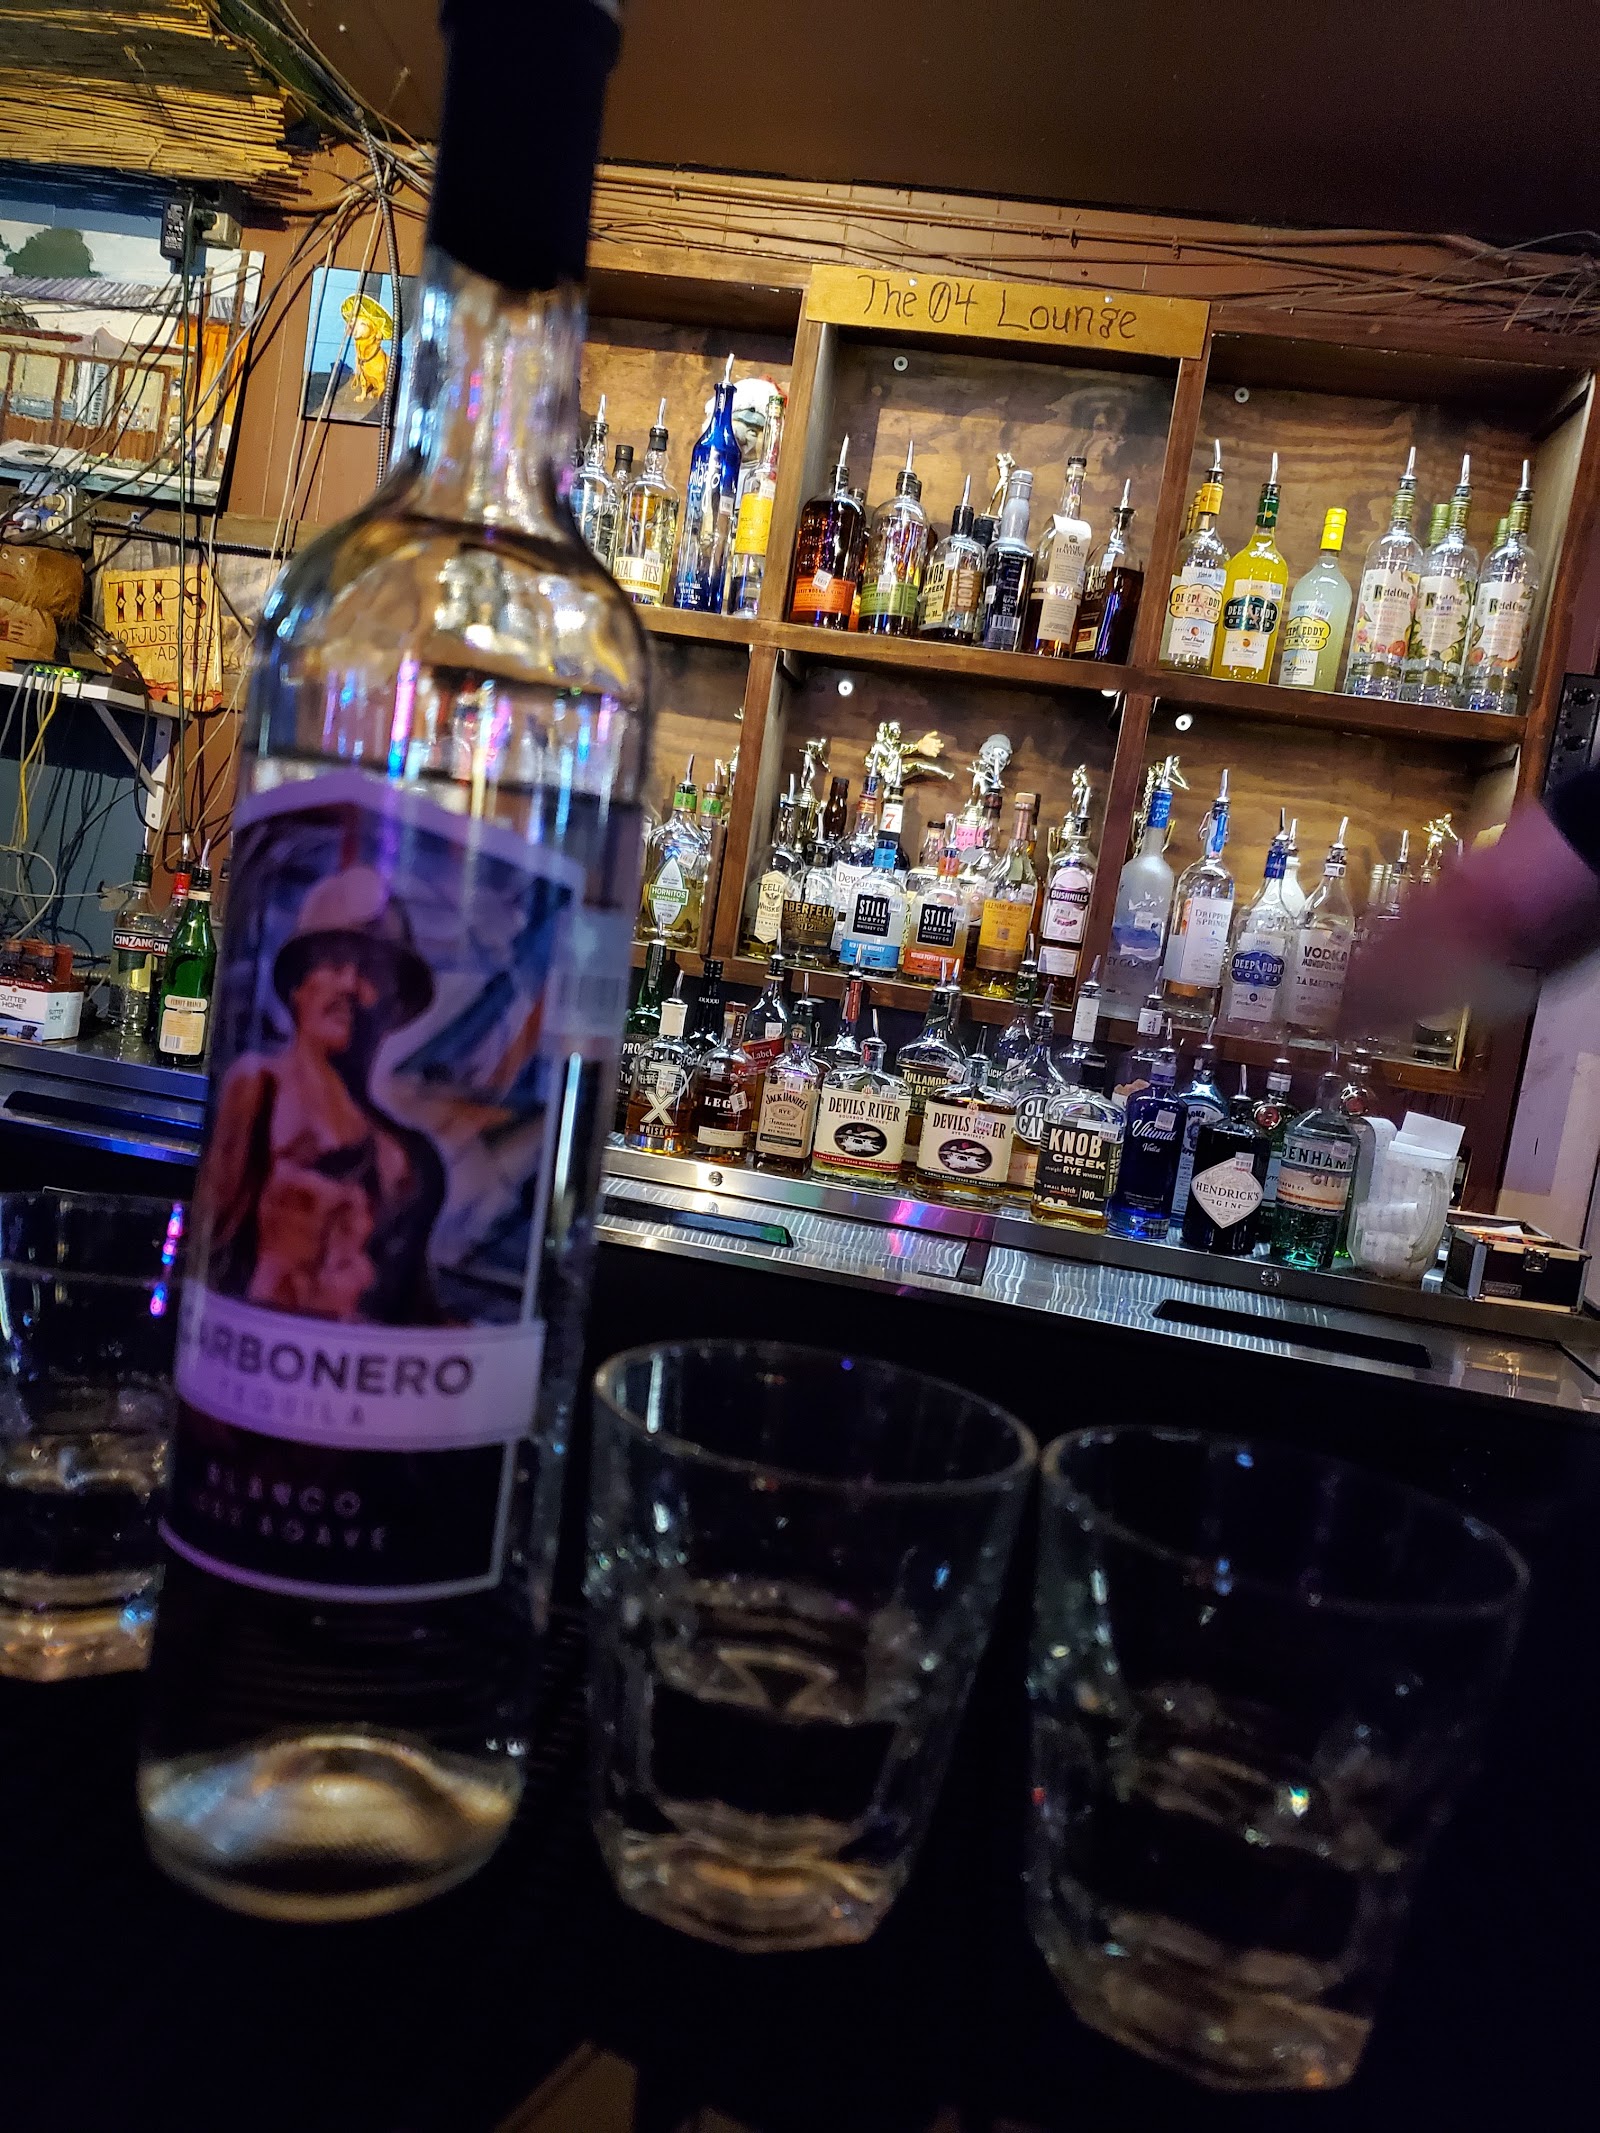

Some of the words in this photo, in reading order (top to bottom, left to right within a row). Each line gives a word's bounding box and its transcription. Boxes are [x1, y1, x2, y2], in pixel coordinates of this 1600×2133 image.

[857, 274, 917, 317] The
[998, 289, 1137, 339] Lounge
[108, 577, 208, 624] TIPS
[652, 888, 686, 899] HORNITOS
[1051, 890, 1089, 902] BUSHMILLS
[859, 899, 887, 918] STILL
[858, 916, 886, 924] AUSTIN
[924, 908, 952, 928] STILL
[922, 926, 951, 934] AUSTIN
[1304, 945, 1348, 962] VODKA
[1235, 958, 1255, 970] DEEP
[1262, 960, 1283, 974] EDDY
[0, 994, 27, 1004] SUTTER
[1, 1000, 24, 1010] HOME
[766, 1093, 783, 1104] JACK
[828, 1096, 866, 1116] DEVILS
[867, 1101, 901, 1122] RIVER
[933, 1112, 972, 1132] DEVILS
[639, 1124, 675, 1137] WHISKEY
[1048, 1128, 1103, 1158] KNOB
[1052, 1153, 1107, 1171] CREEK
[1062, 1165, 1082, 1176] RYE
[1082, 1172, 1105, 1180] WHISKEY
[1060, 1184, 1076, 1194] batch
[1082, 1189, 1095, 1200] 100
[1195, 1181, 1259, 1201] HENDRICK'S
[1216, 1200, 1237, 1209] GIN
